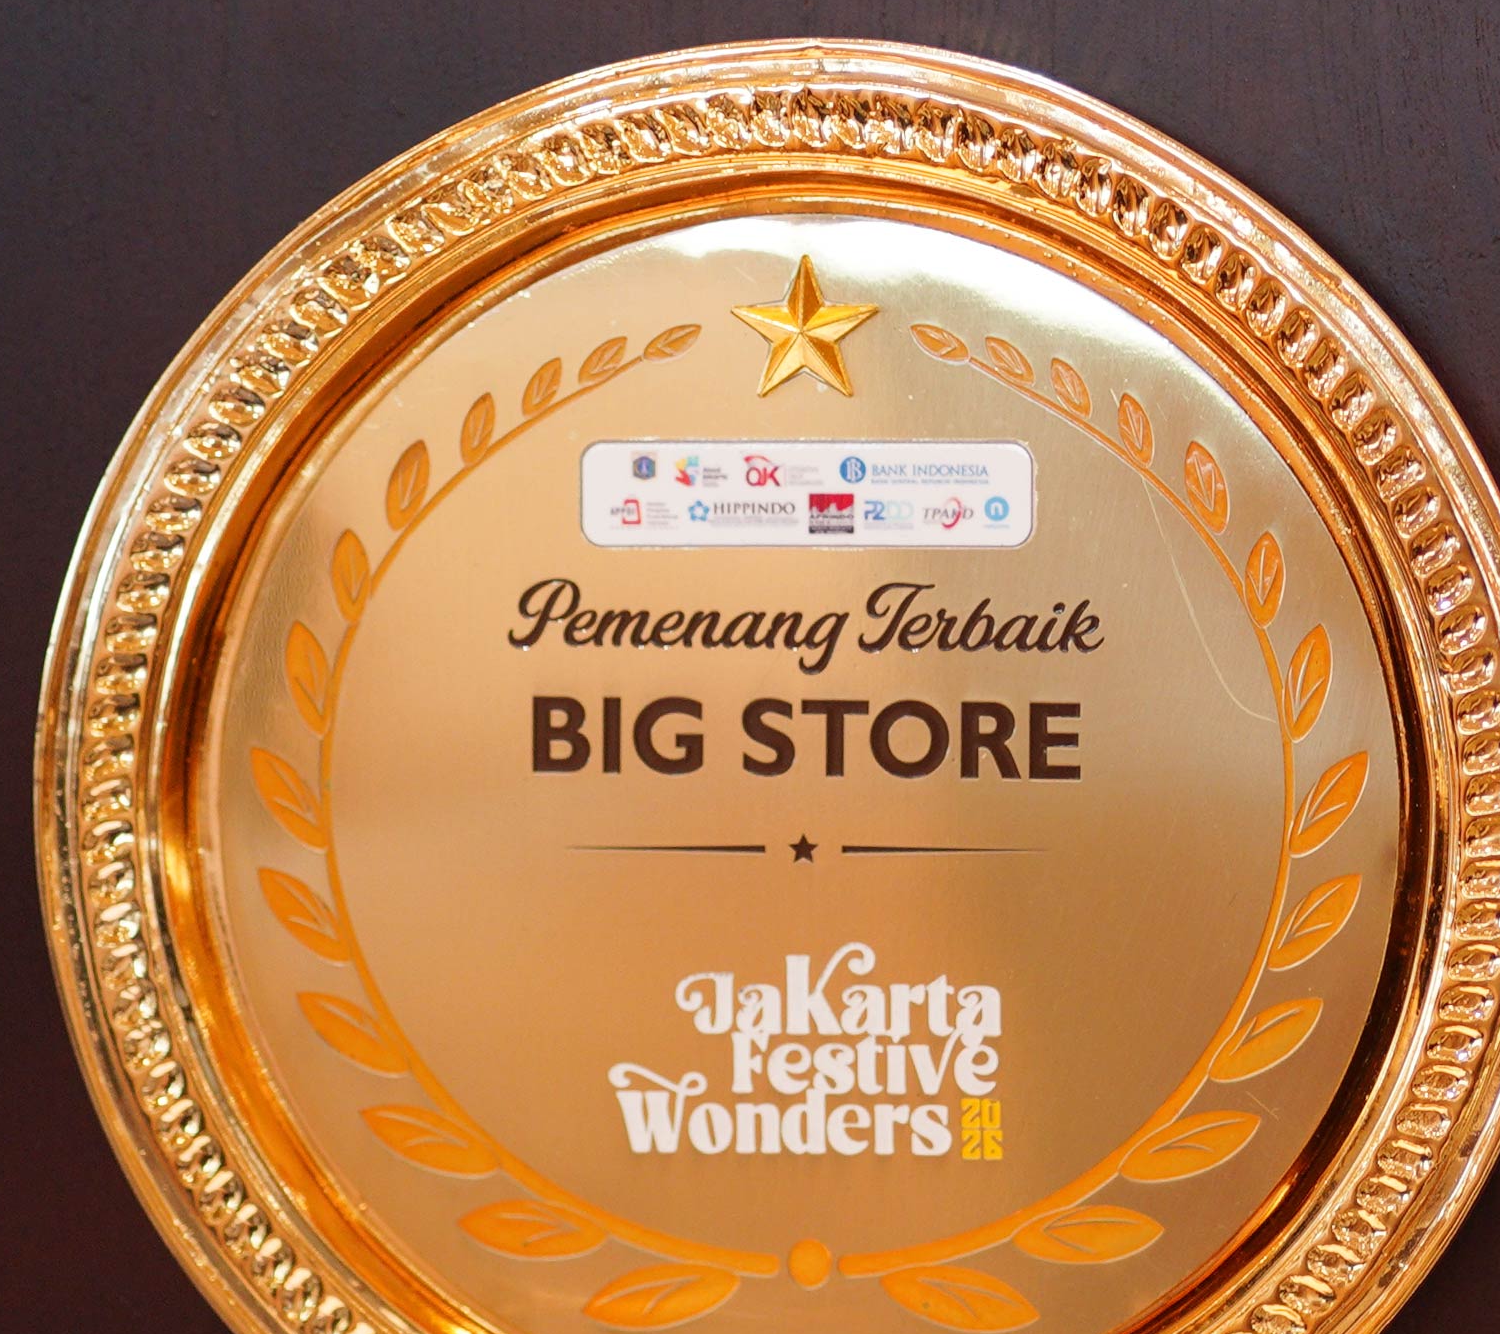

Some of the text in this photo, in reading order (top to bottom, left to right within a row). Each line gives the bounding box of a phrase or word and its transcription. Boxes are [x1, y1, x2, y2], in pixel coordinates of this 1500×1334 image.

[713, 502, 796, 515] HIPPINDO
[871, 464, 989, 477] BANK INDONESIA
[508, 578, 1105, 674] Pemenang Terbaik
[532, 697, 1081, 780] BIG STORE
[608, 1063, 952, 1156] Wonders
